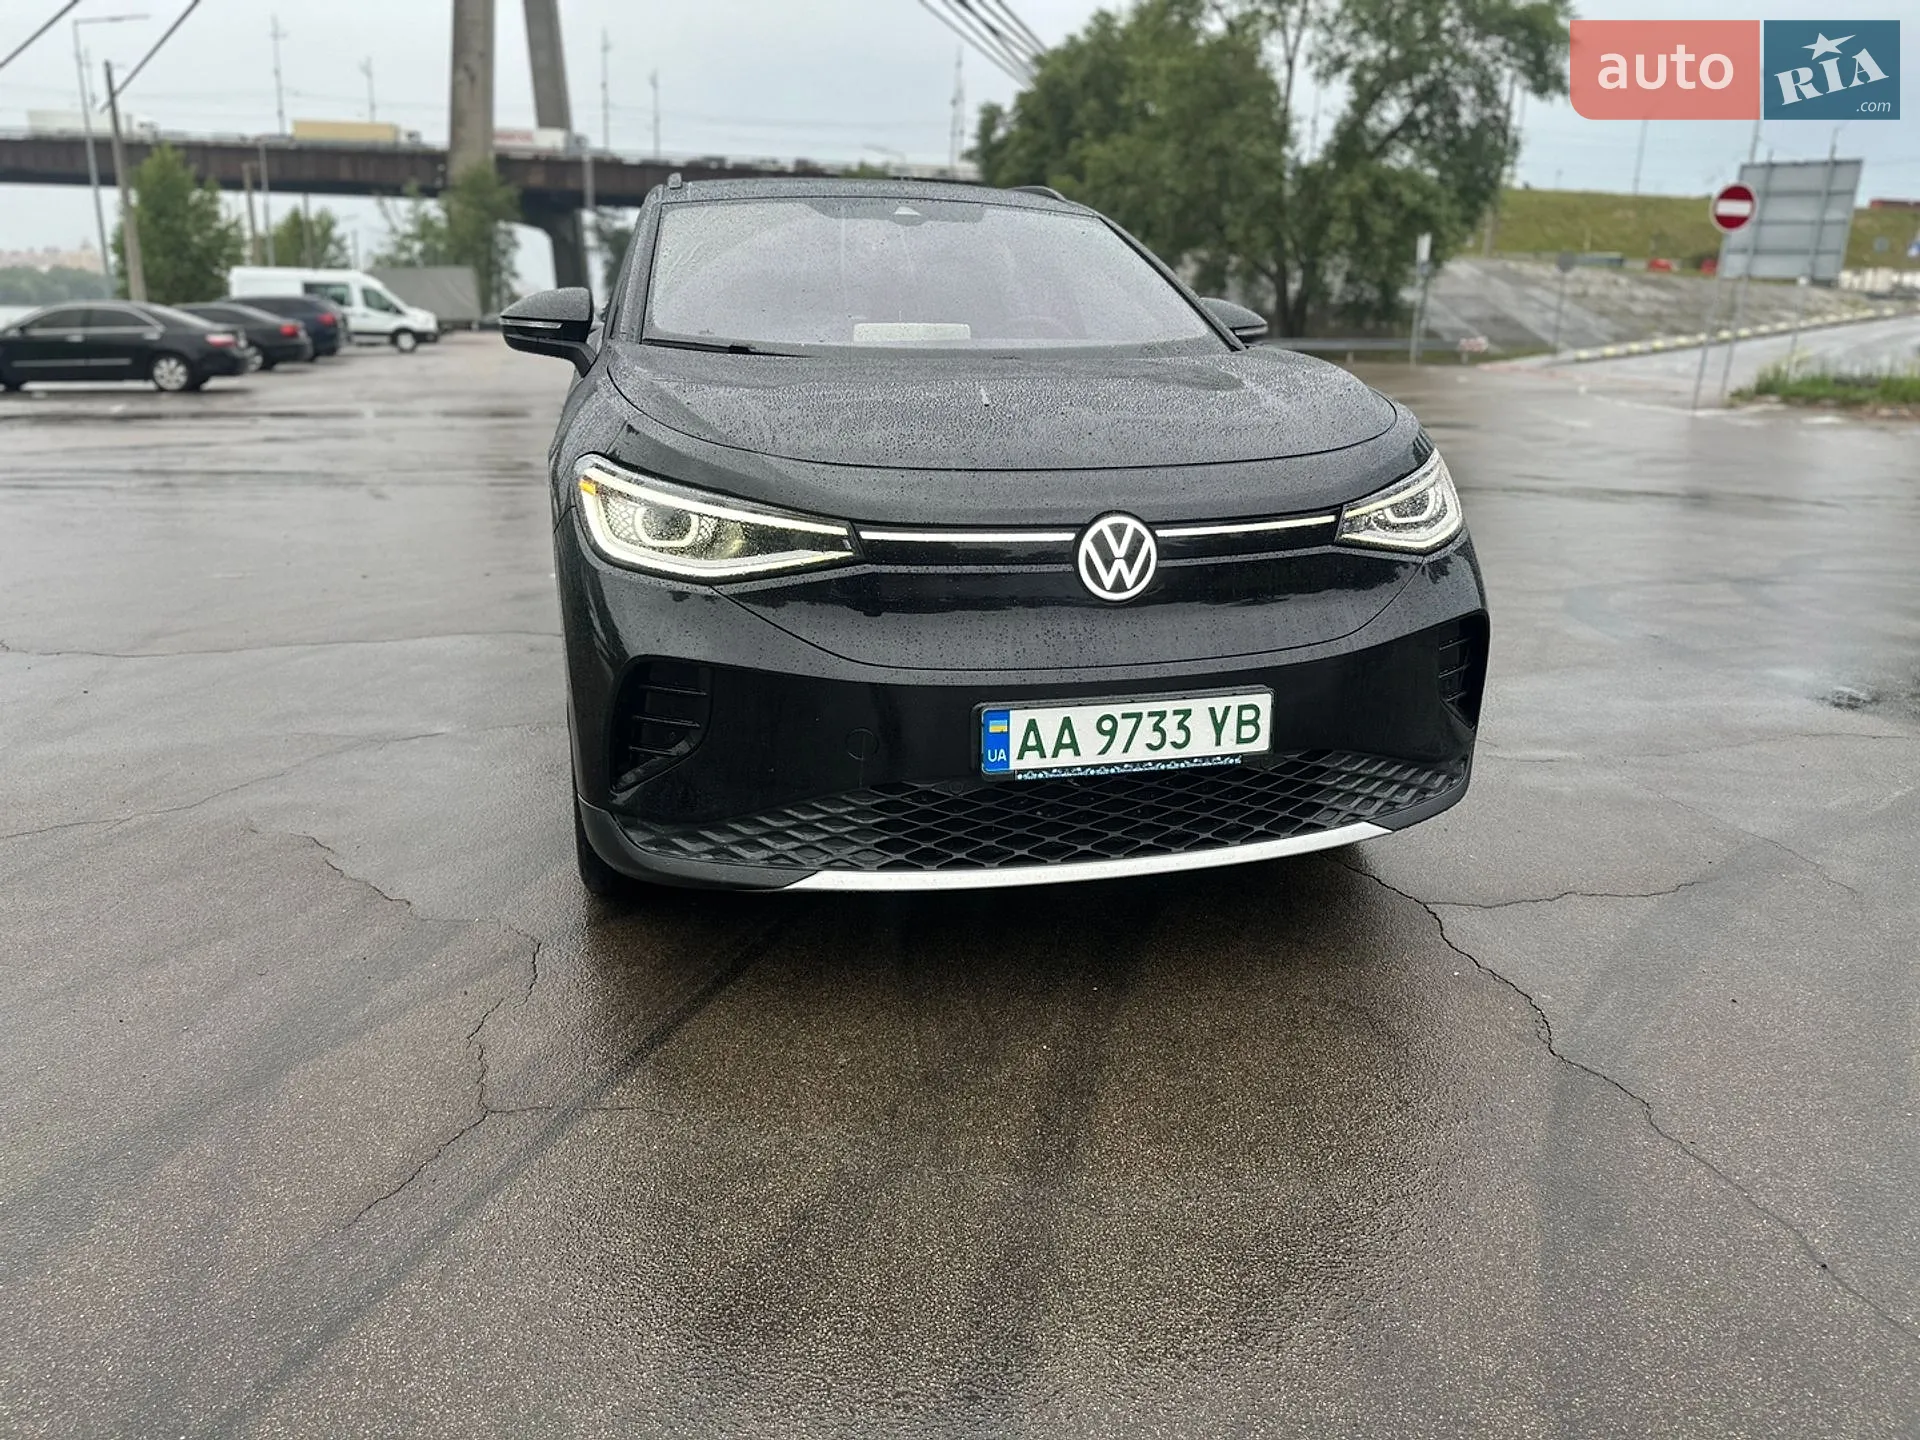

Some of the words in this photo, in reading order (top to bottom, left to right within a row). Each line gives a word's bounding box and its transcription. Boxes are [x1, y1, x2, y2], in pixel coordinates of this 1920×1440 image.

[1016, 716, 1081, 760] AA
[1095, 708, 1193, 756] 9733
[1208, 703, 1262, 746] YB
[987, 748, 1007, 763] UA
